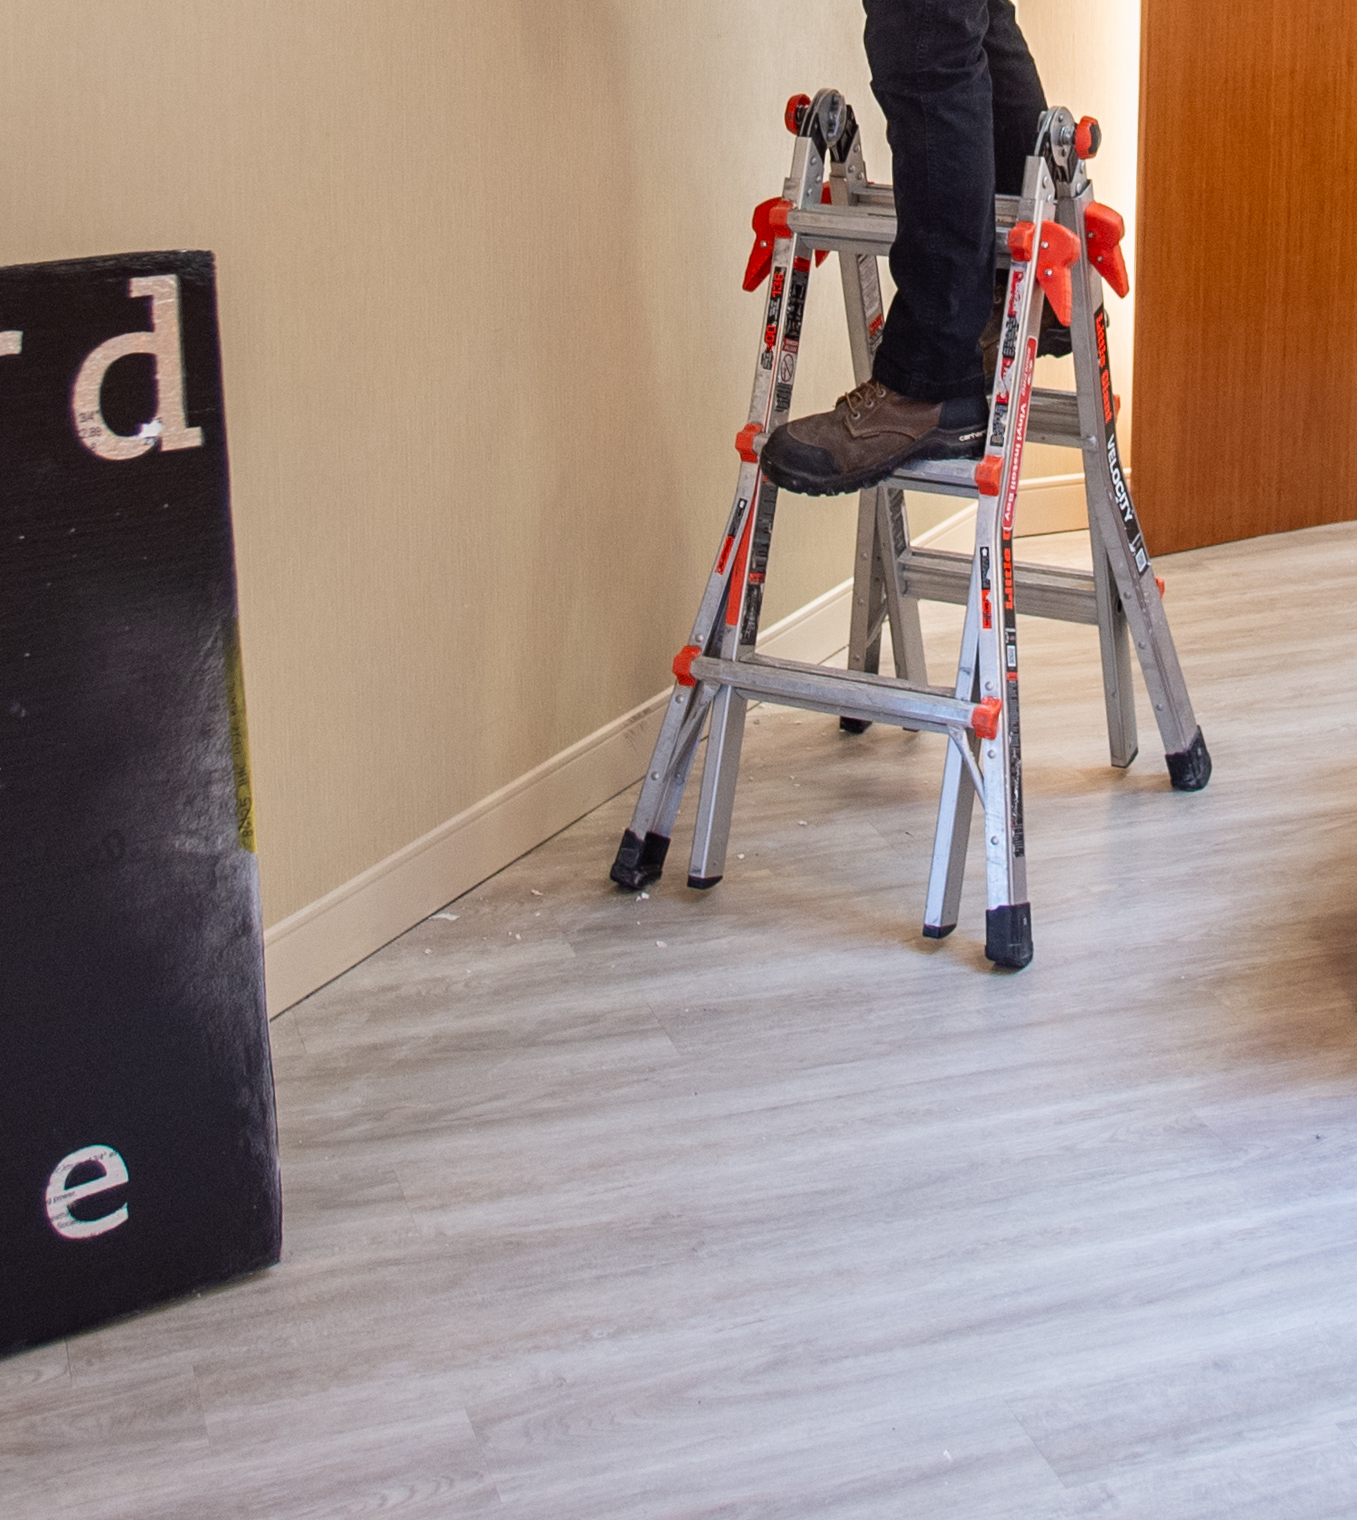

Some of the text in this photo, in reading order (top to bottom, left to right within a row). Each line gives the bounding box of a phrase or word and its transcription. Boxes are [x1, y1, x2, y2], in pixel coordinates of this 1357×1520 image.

[1004, 403, 1027, 522] Vinyl Install Bay
[1107, 434, 1134, 523] VELOCITY
